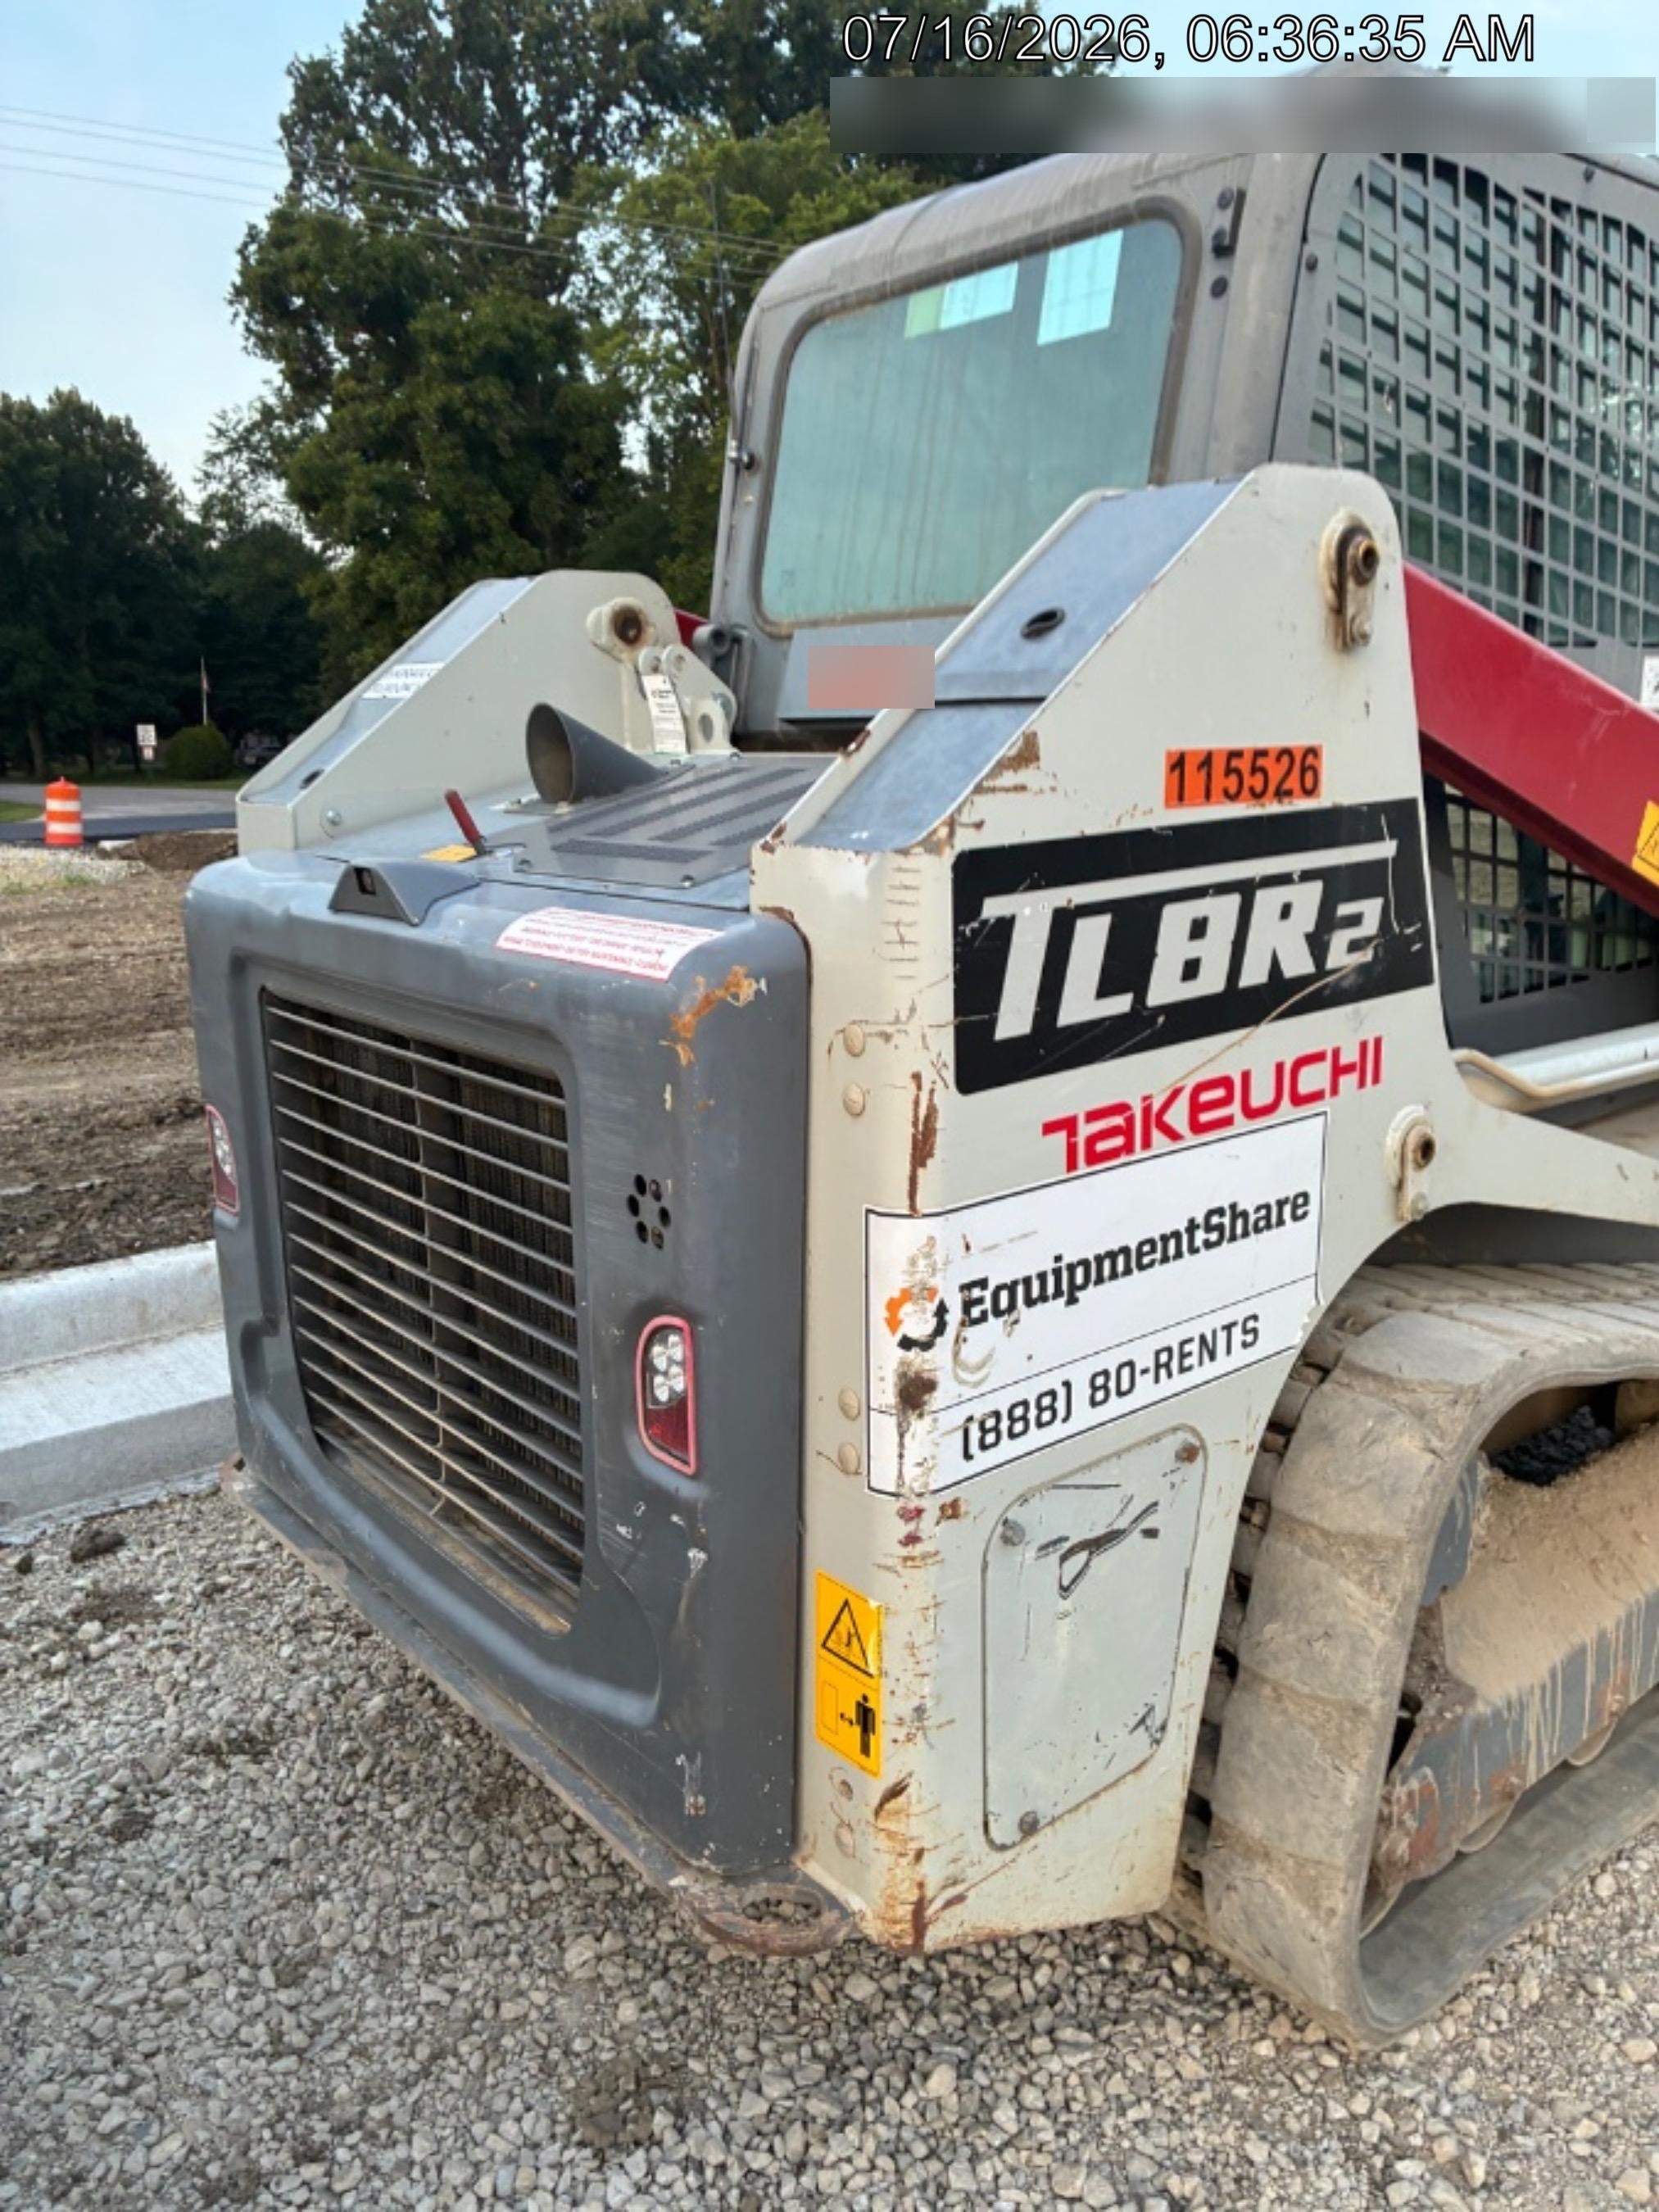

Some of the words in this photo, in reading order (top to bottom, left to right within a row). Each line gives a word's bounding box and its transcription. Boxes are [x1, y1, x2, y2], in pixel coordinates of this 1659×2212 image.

[1168, 746, 1321, 803] 115526
[981, 840, 1398, 1042] TL8R2
[959, 1190, 1311, 1328] EquipmentShare
[962, 1380, 1073, 1462] (888)
[1087, 1313, 1261, 1409] 80-RENTS
